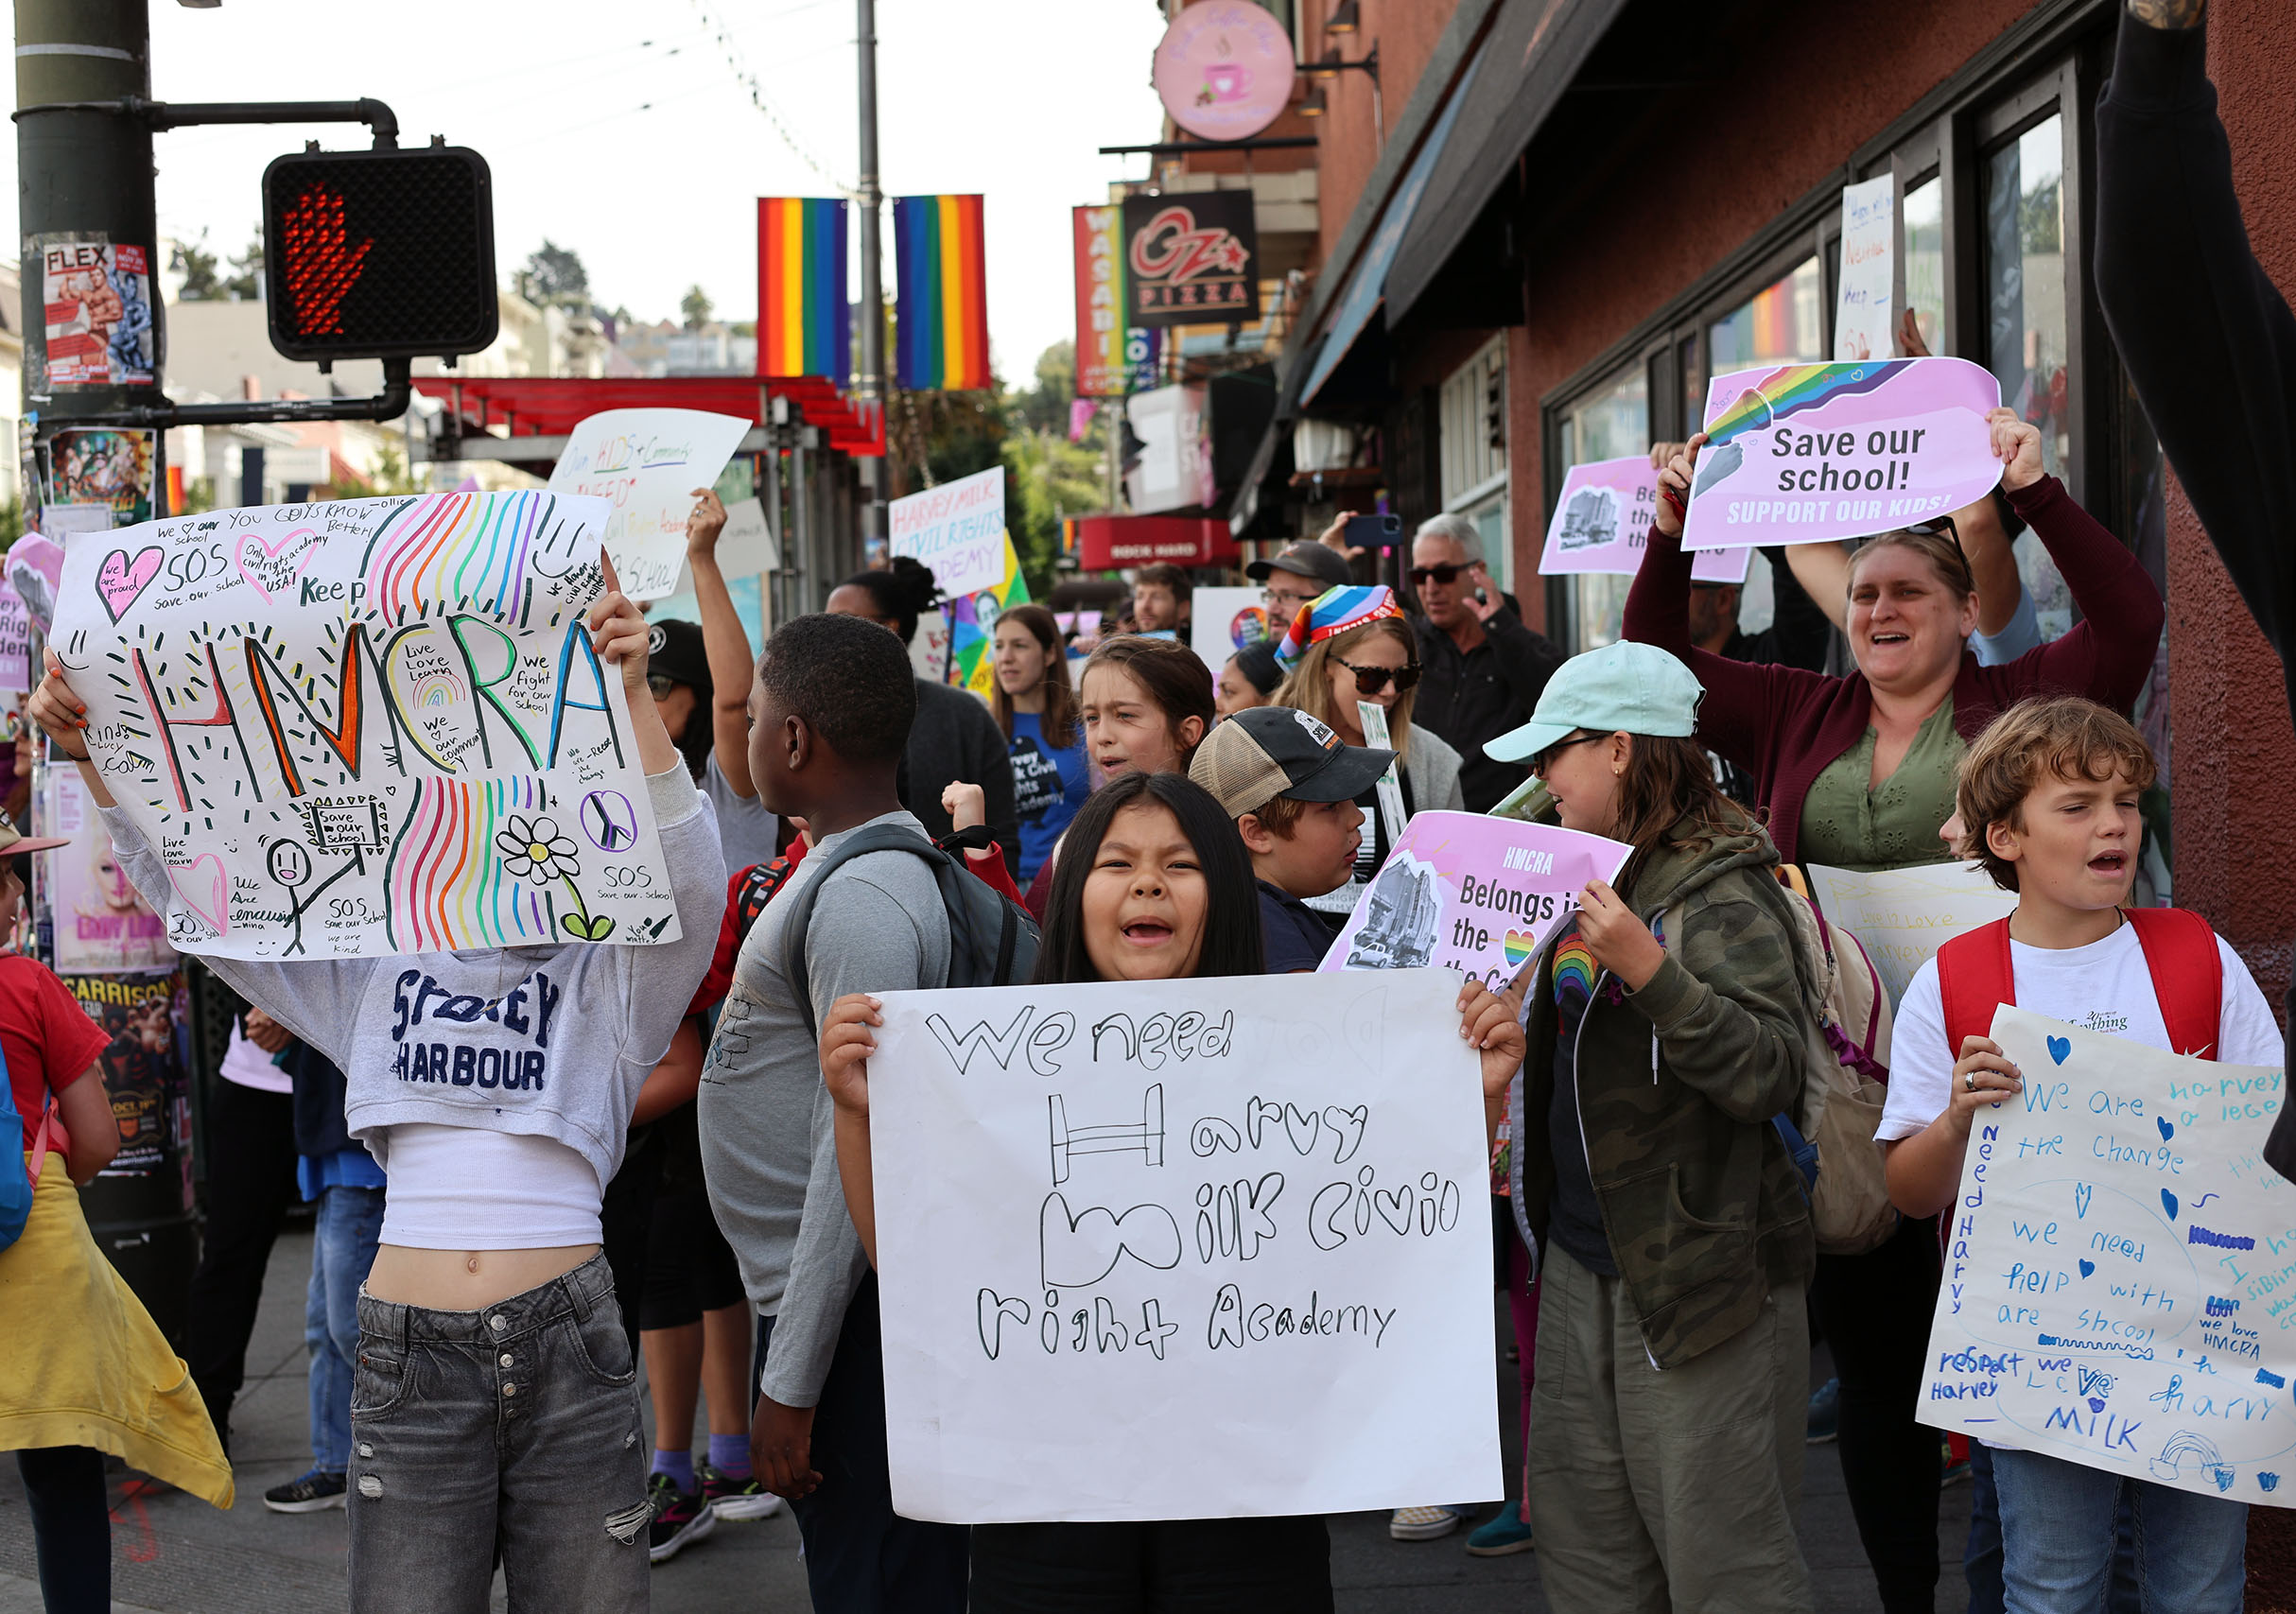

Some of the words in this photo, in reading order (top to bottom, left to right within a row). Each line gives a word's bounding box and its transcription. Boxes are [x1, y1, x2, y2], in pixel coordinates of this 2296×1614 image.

[47, 246, 108, 270] FLEX
[1139, 284, 1247, 305] PIZZA
[1771, 428, 1854, 457] Save
[1867, 428, 1925, 454] our
[1778, 460, 1909, 492] school!
[893, 492, 954, 534] HARVEY
[954, 477, 996, 510] MILK
[1727, 500, 1832, 524] SUPPORT
[1835, 500, 1883, 520] OUR
[1888, 494, 1952, 518] KIDS!
[175, 532, 208, 546] school
[895, 525, 946, 557] CIVIL
[947, 507, 1003, 546] RIGHTS
[245, 545, 266, 561] Only
[288, 535, 328, 560] academy
[1111, 545, 1152, 559] ROCK
[1155, 543, 1196, 557] HARD
[100, 578, 115, 586] are
[257, 572, 267, 581] in
[275, 565, 294, 577] the
[107, 573, 139, 599] proud
[300, 576, 366, 608] Keep
[405, 644, 436, 658] Live
[406, 655, 449, 669] Love
[410, 668, 452, 681] Learn
[516, 670, 551, 690] fight
[508, 686, 527, 699] for
[532, 691, 552, 700] our
[515, 699, 548, 715] school
[435, 738, 459, 753] our
[320, 811, 354, 823] Save
[328, 832, 366, 842] school
[337, 824, 363, 833] our
[163, 836, 186, 847] Live
[1503, 847, 1554, 876] HMCRA
[231, 892, 258, 904] Are
[645, 889, 672, 900] school
[1460, 875, 1554, 925] Belongs
[1452, 918, 1488, 951] the
[1092, 1009, 1233, 1071] need
[396, 1042, 546, 1091] HARBOUR
[1048, 1083, 1370, 1188] Harvy
[2018, 1135, 2064, 1159] the
[2093, 1135, 2184, 1175] change
[2002, 1260, 2070, 1294] help
[2111, 1281, 2175, 1311] with
[977, 1286, 1178, 1362] right
[1208, 1282, 1399, 1349] Academy
[1997, 1303, 2041, 1327] are
[2232, 1319, 2259, 1340] love
[2203, 1332, 2261, 1362] HMCRA
[1931, 1380, 1998, 1400] Harvey
